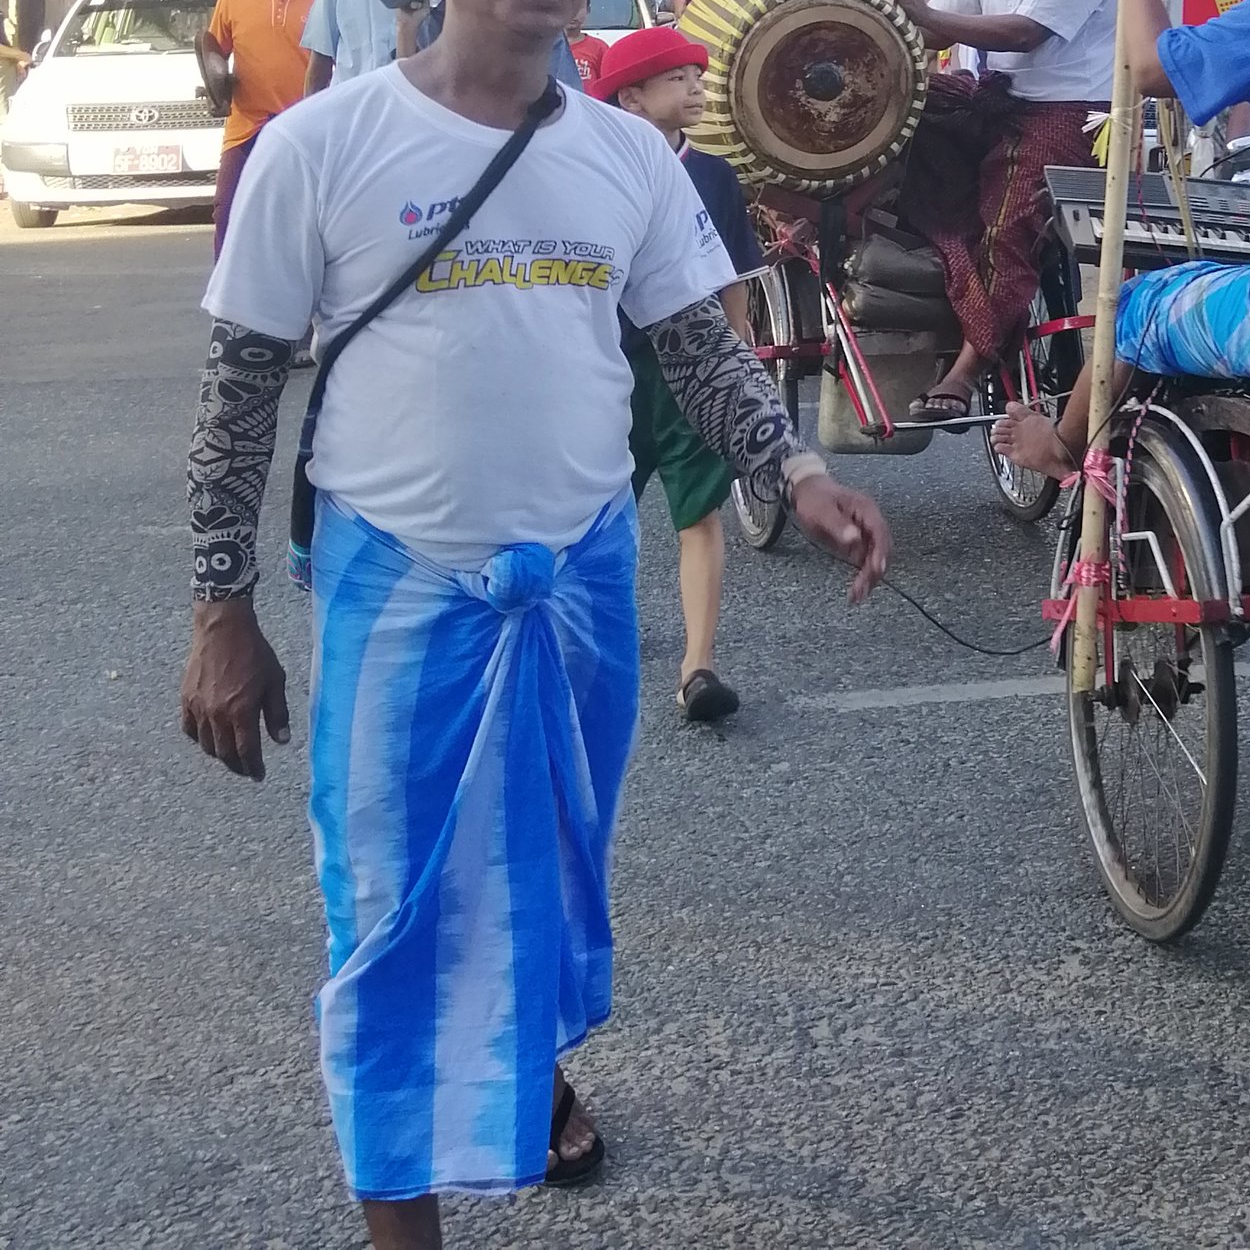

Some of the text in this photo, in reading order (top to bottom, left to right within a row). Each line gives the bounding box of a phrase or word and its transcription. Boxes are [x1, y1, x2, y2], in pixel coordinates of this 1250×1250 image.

[426, 196, 464, 221] pt
[464, 239, 616, 260] WHAT IS YOUR
